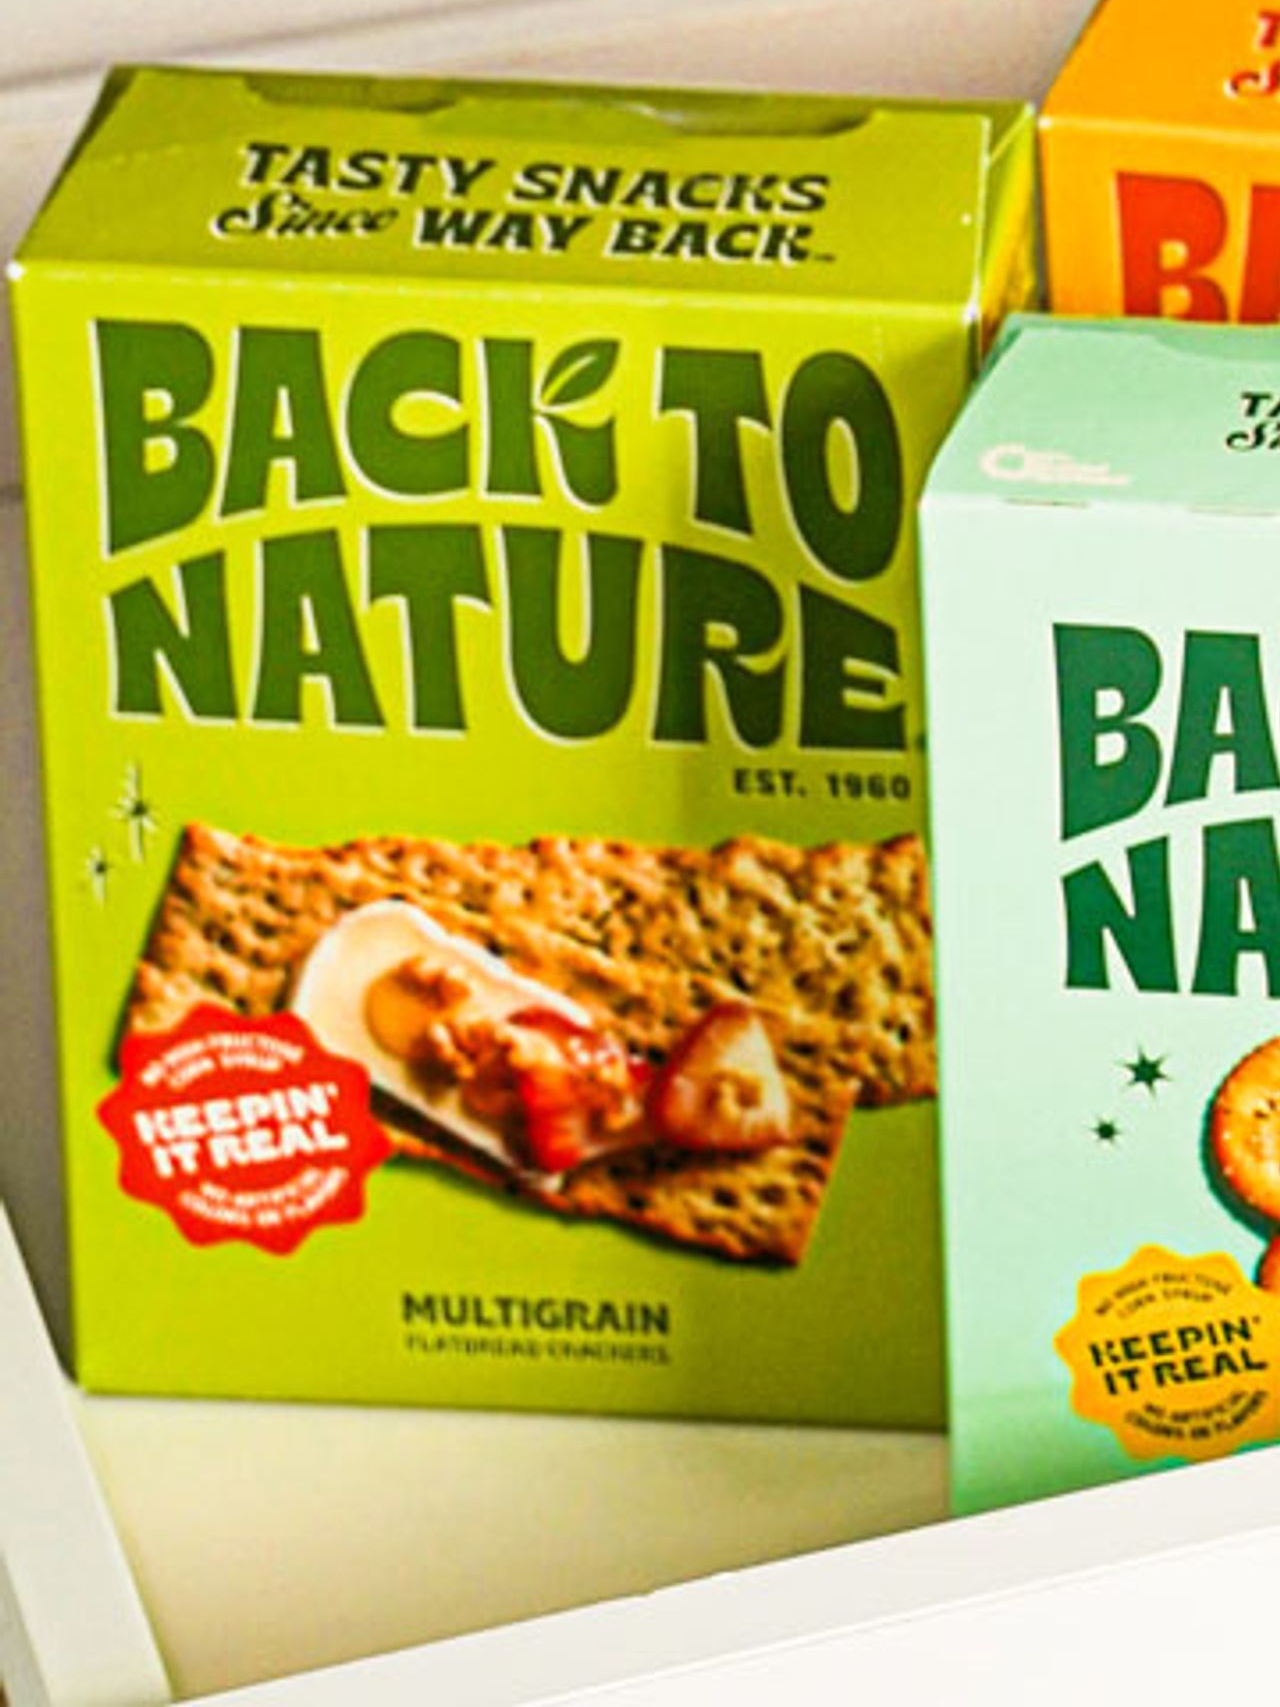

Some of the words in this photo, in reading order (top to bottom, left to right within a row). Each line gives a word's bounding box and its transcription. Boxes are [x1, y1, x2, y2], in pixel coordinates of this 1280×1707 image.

[240, 142, 495, 194] TASTY
[511, 163, 828, 214] SNACKS
[211, 189, 401, 242] Since
[412, 207, 598, 254] WAY
[89, 318, 621, 558] BACK
[652, 345, 902, 581] TO
[108, 521, 908, 755] NATURE
[733, 768, 805, 798] EST.
[827, 772, 912, 802] 1960
[134, 1082, 338, 1145] KEEPIN'
[152, 1141, 198, 1178] IT
[209, 1119, 347, 1168] REAL
[403, 1292, 670, 1335] MULTIGRAIN
[1089, 1315, 1261, 1367] KEEPIN'
[1104, 1367, 1140, 1395] IT
[1153, 1348, 1268, 1387] REAL
